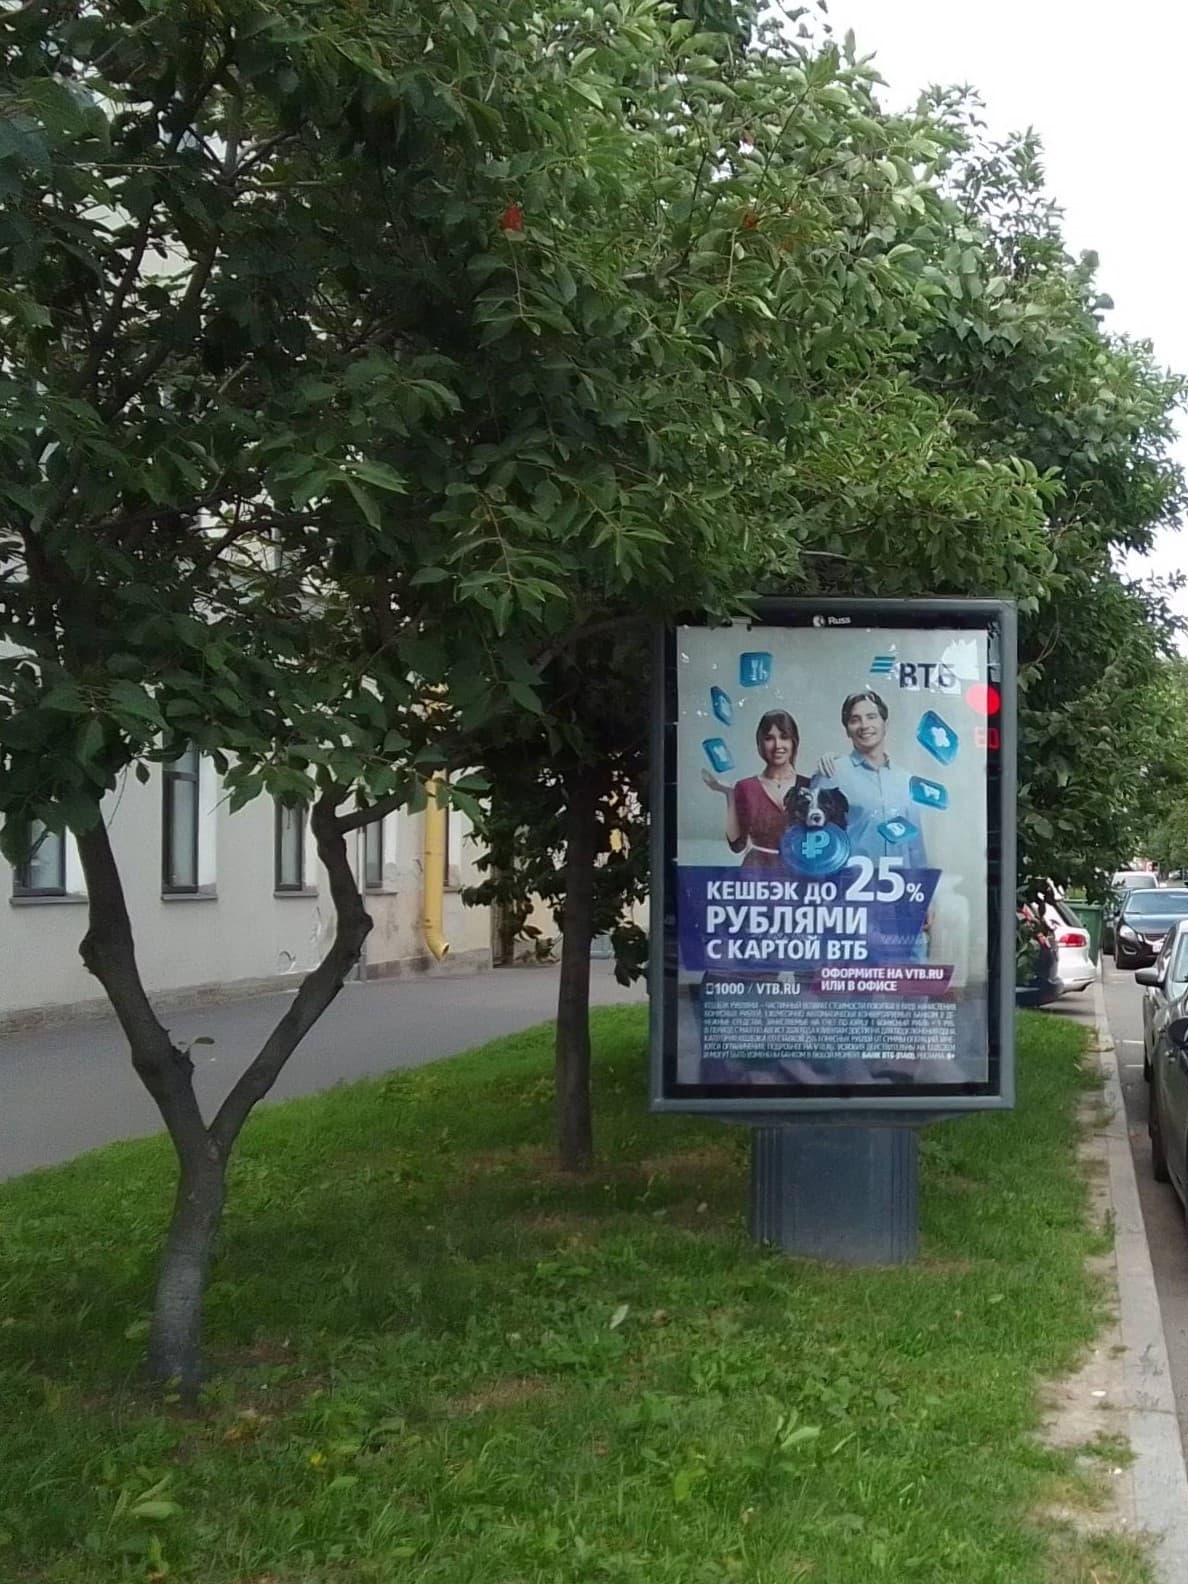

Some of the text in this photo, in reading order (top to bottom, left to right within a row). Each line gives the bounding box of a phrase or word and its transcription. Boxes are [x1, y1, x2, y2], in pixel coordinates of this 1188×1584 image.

[707, 881, 799, 901] КЕШБЭК
[804, 882, 837, 904] ДО
[706, 906, 868, 935] РУБЛЯМИ
[707, 935, 868, 960] С КАРТОЙ ВТБ
[821, 967, 944, 980] ОФОРМИТЕ НА VTB.RU
[715, 983, 745, 995] 1000
[756, 983, 801, 995] VTB.RU
[821, 980, 898, 992] ИЛИ В ОФИСЕ
